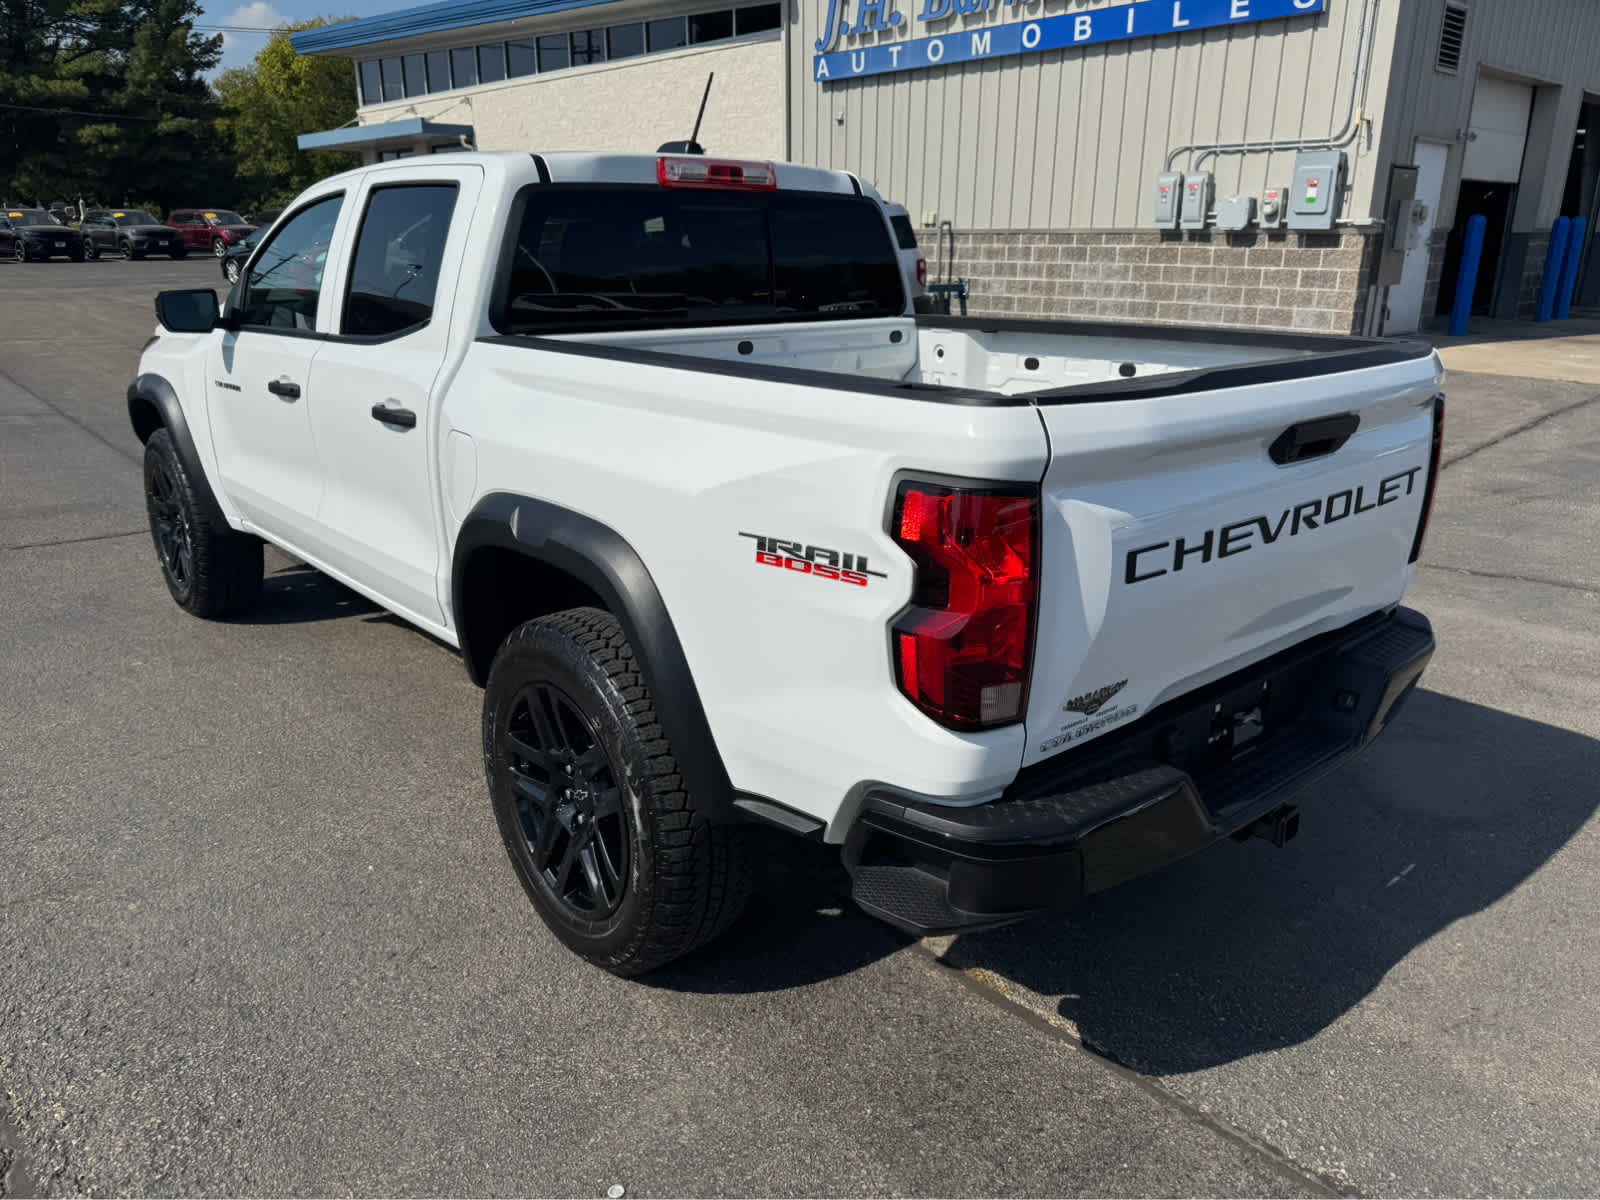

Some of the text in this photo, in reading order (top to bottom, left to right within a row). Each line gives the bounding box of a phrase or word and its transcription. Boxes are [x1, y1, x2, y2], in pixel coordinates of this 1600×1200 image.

[1124, 465, 1422, 585] CHEVROLET
[737, 530, 888, 579] TRAIL
[755, 551, 868, 587] BOSS
